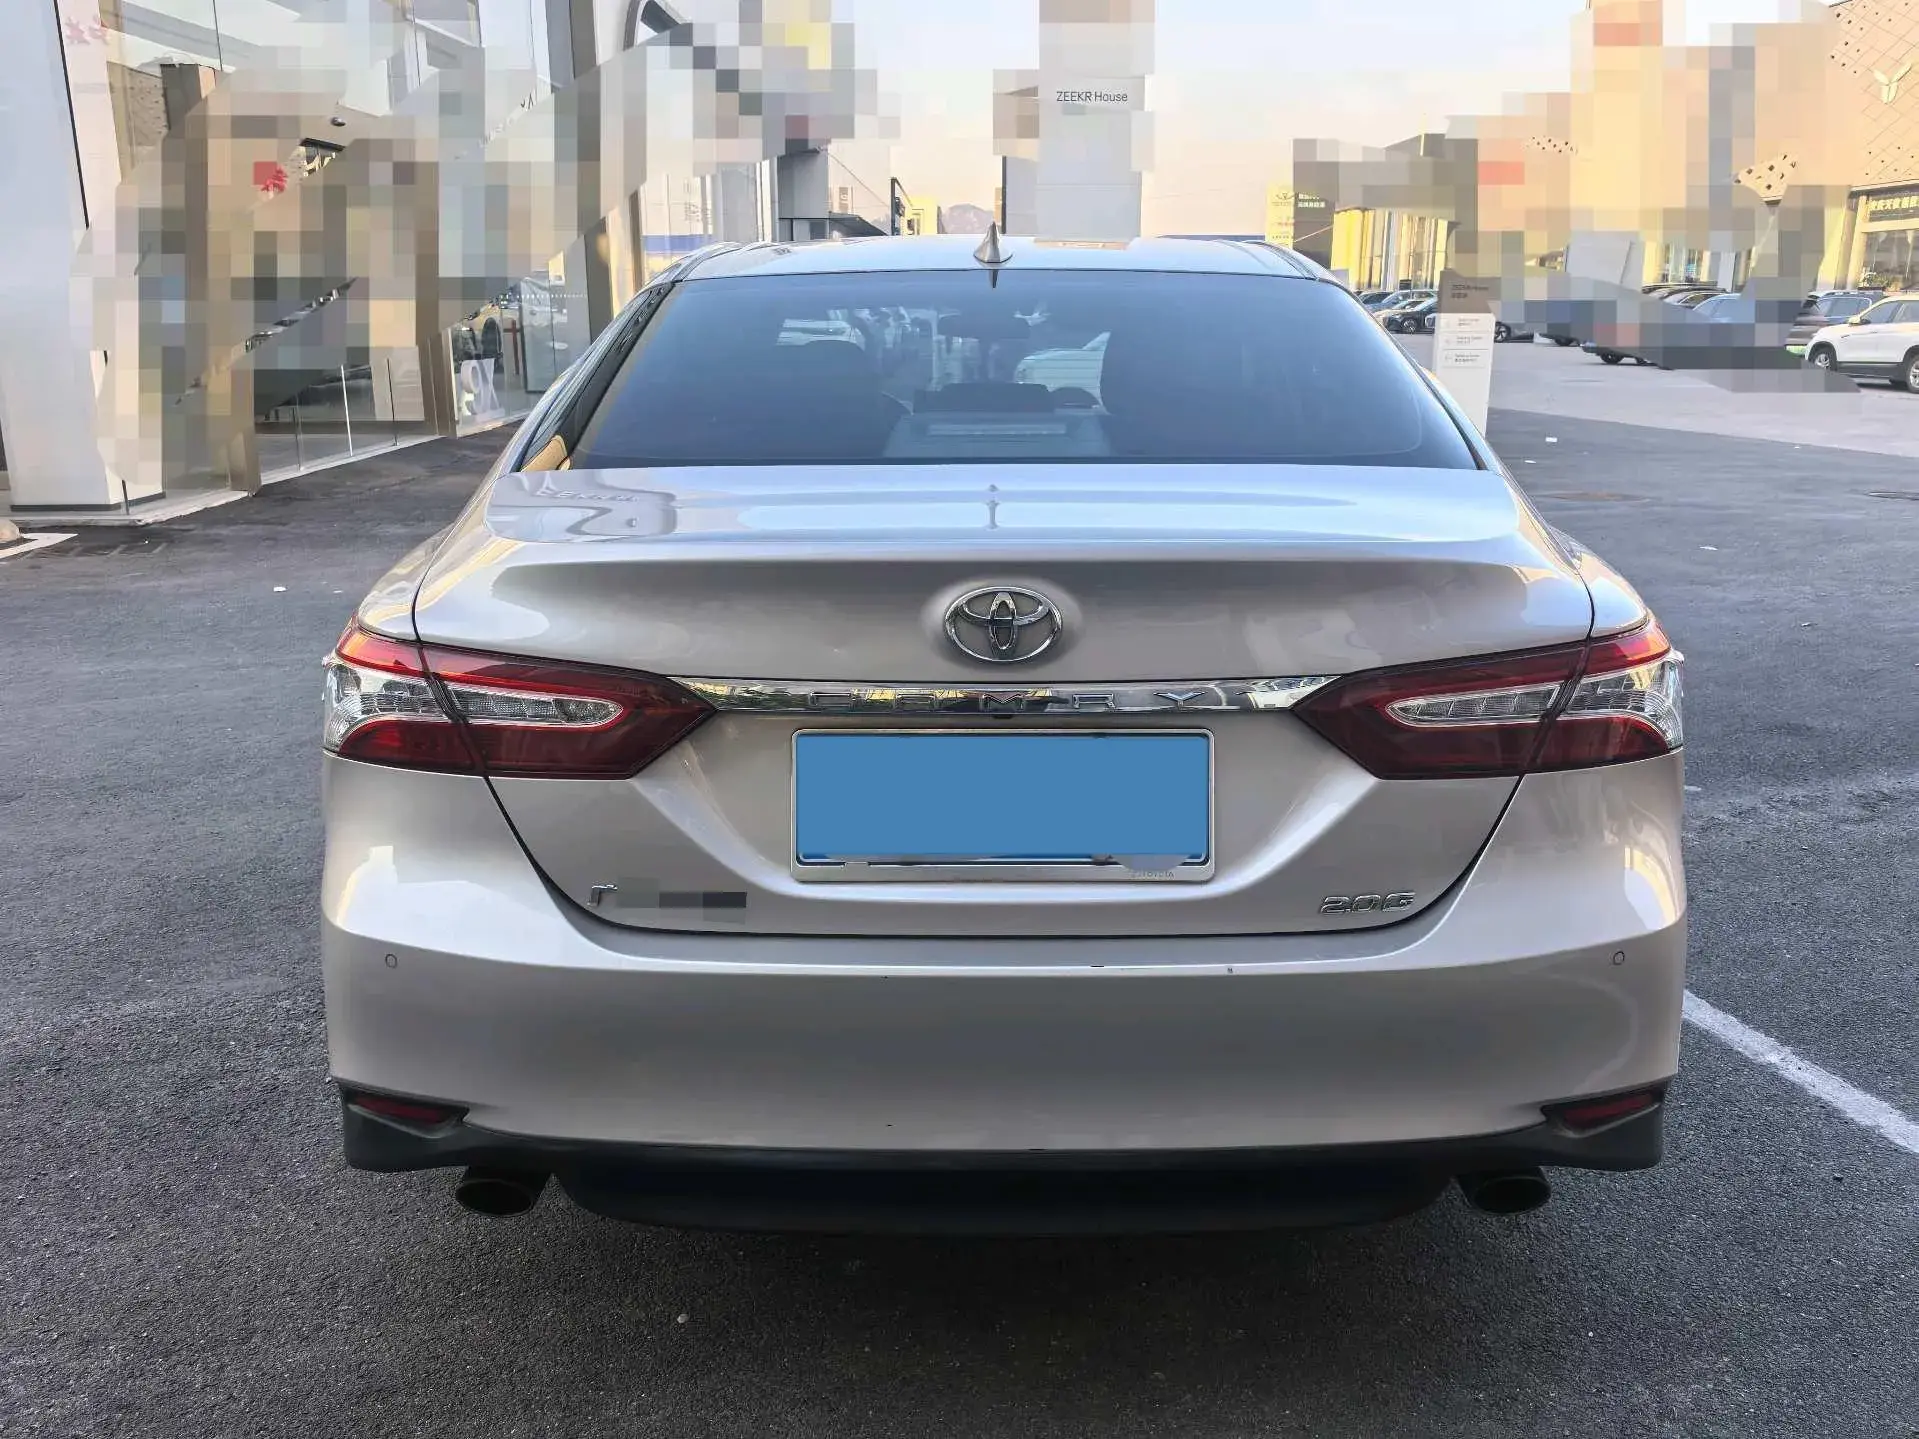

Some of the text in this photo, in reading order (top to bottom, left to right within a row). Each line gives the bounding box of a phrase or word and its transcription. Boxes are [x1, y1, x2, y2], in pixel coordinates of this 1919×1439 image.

[1056, 91, 1128, 102] ZEEKR House
[808, 690, 1208, 712] CAMRY
